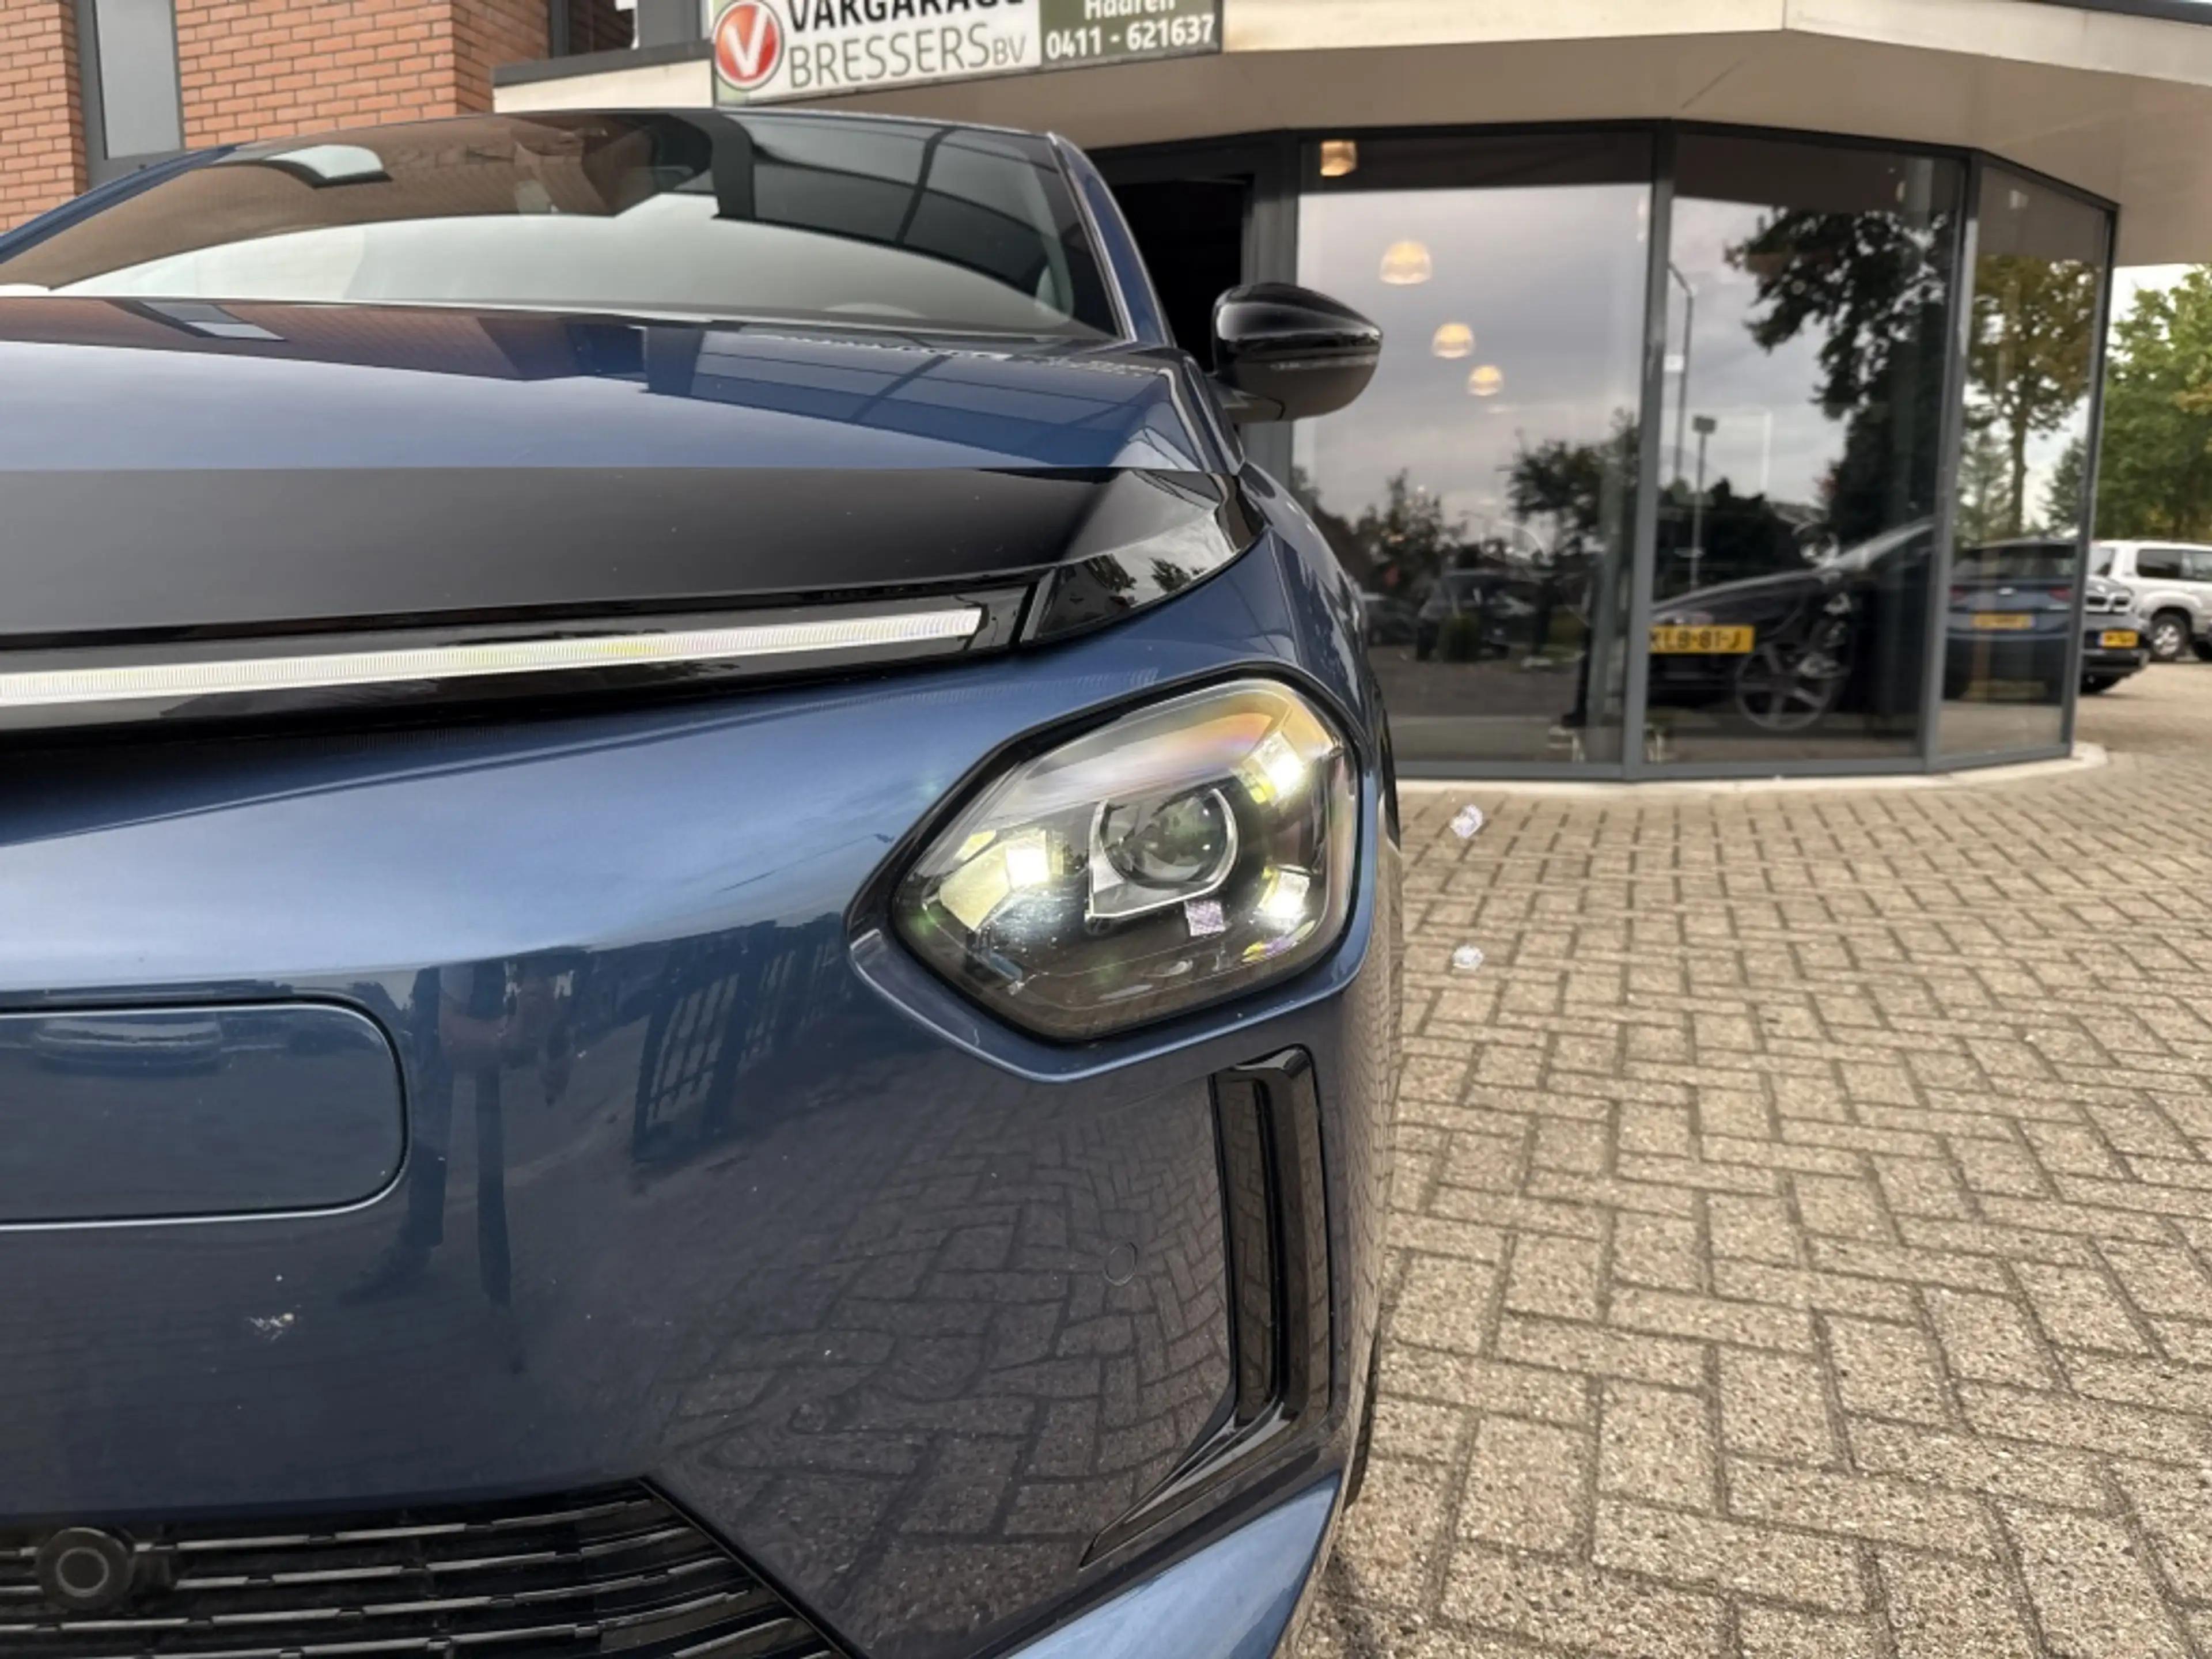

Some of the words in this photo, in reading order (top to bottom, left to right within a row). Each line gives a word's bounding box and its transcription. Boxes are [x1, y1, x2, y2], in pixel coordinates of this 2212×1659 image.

[789, 0, 1023, 32] VAKGA
[1046, 26, 1103, 59] 0411
[1126, 14, 1215, 50] 621637
